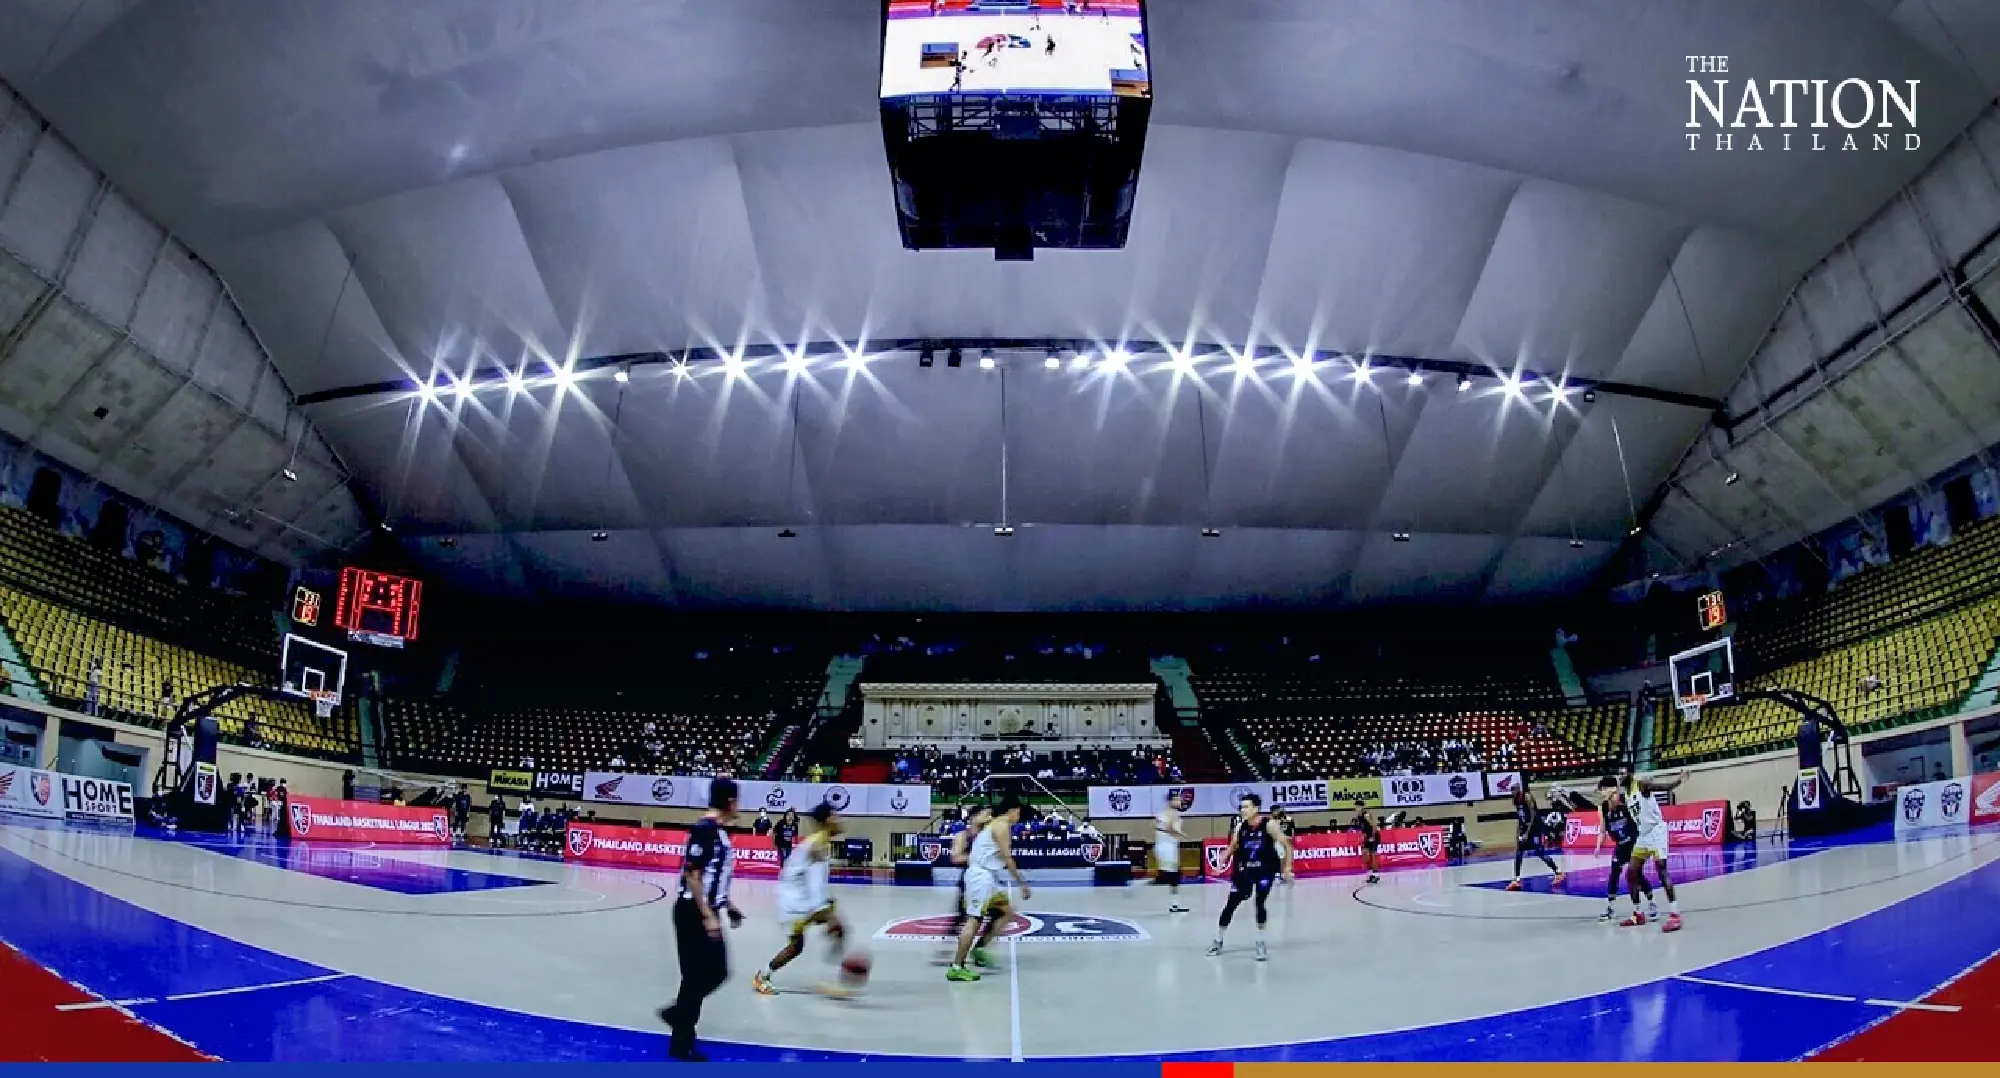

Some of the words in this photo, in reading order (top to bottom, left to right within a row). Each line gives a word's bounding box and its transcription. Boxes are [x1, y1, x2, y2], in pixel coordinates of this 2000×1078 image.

[536, 771, 583, 792] HOME
[62, 777, 132, 814] HOME
[1272, 783, 1327, 802] HOME
[1396, 794, 1424, 803] PLUS
[593, 838, 643, 853] THAILAND
[644, 842, 686, 857] BASKET
[732, 847, 751, 860] GUE
[751, 849, 778, 861] 2022
[1046, 848, 1081, 856] LEAGUE
[1294, 845, 1356, 860] BASKETBALL
